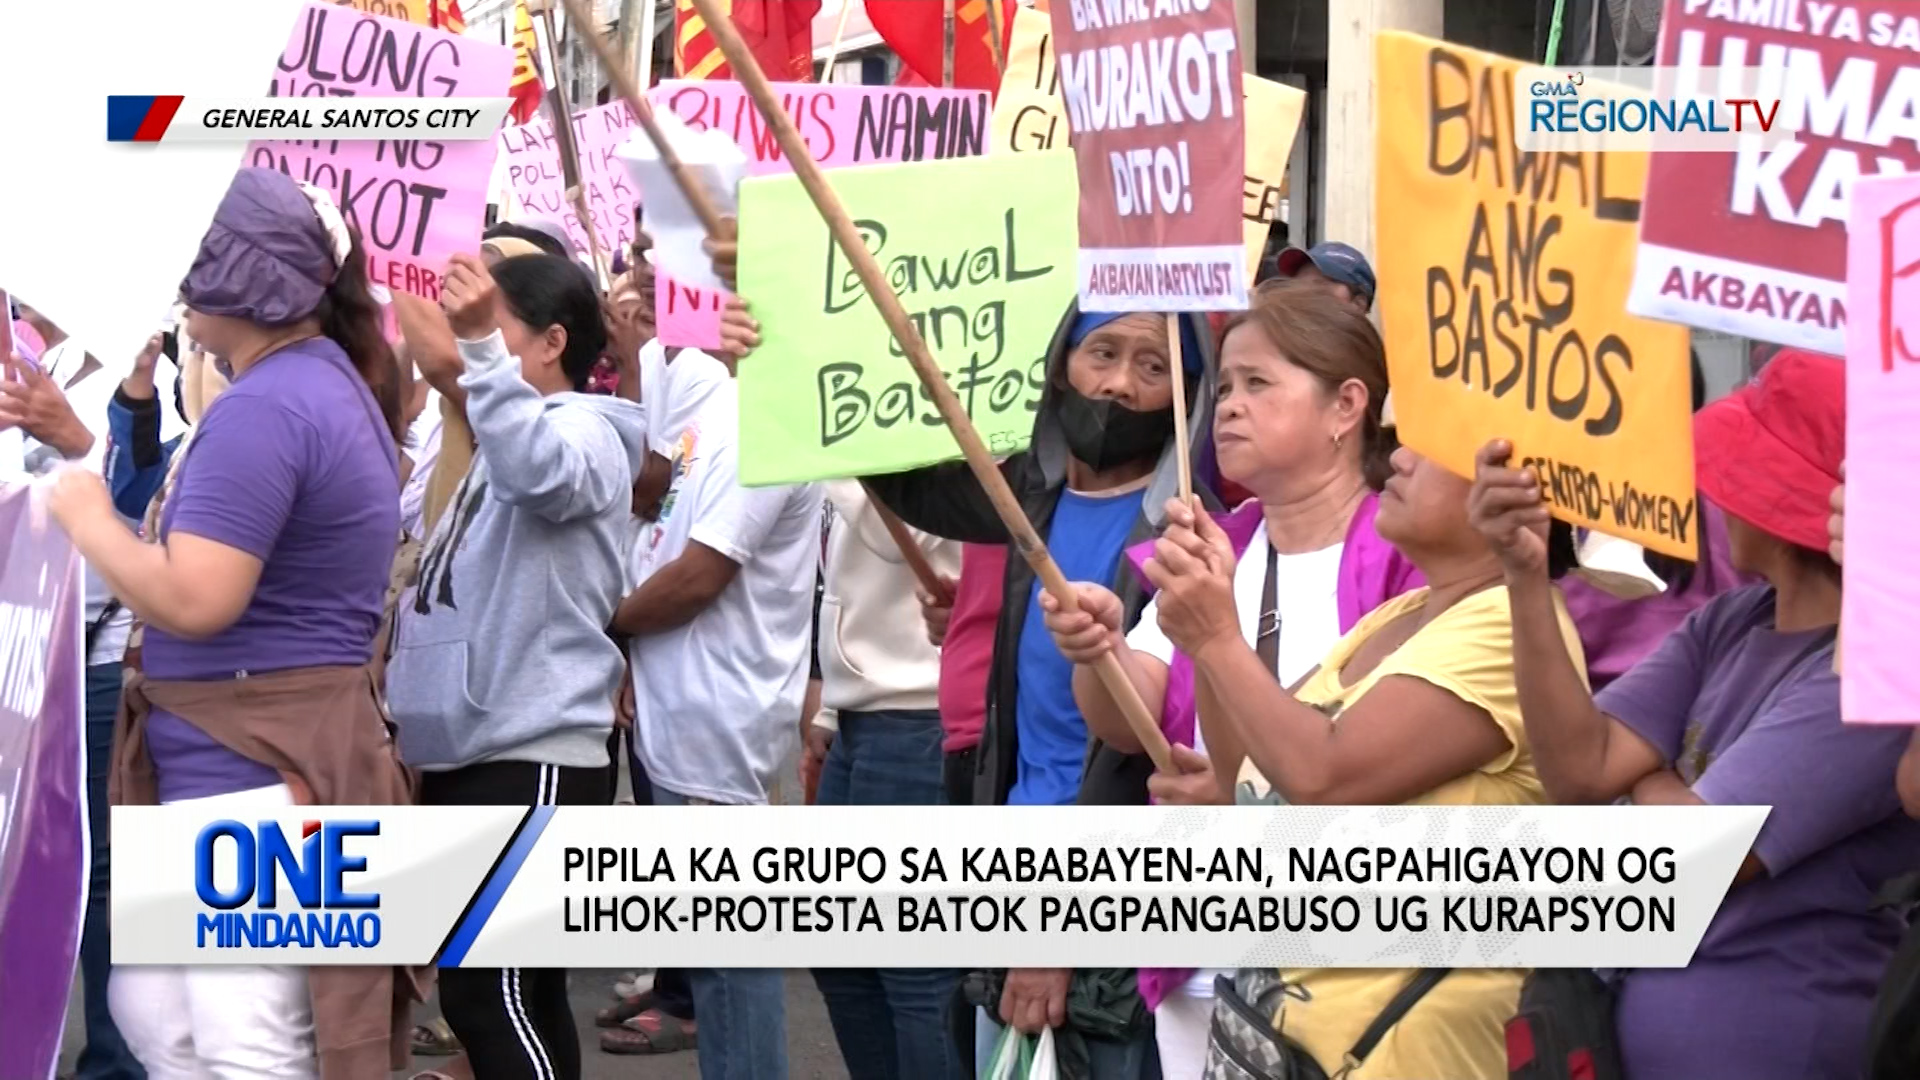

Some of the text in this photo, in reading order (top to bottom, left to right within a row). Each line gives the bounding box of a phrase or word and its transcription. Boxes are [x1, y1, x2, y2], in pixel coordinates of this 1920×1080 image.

[1060, 27, 1236, 133] KURAKOT
[502, 113, 587, 154] LAHT
[853, 92, 987, 162] NAMIN
[1428, 46, 1642, 222] BAWAL
[1110, 140, 1192, 216] DITO!
[1088, 263, 1232, 296] AKBAYAN PARTYLIST
[1462, 200, 1575, 326] ANG
[1427, 265, 1634, 437] BASTOS
[1522, 456, 1694, 544] ENTRO-WOMEN
